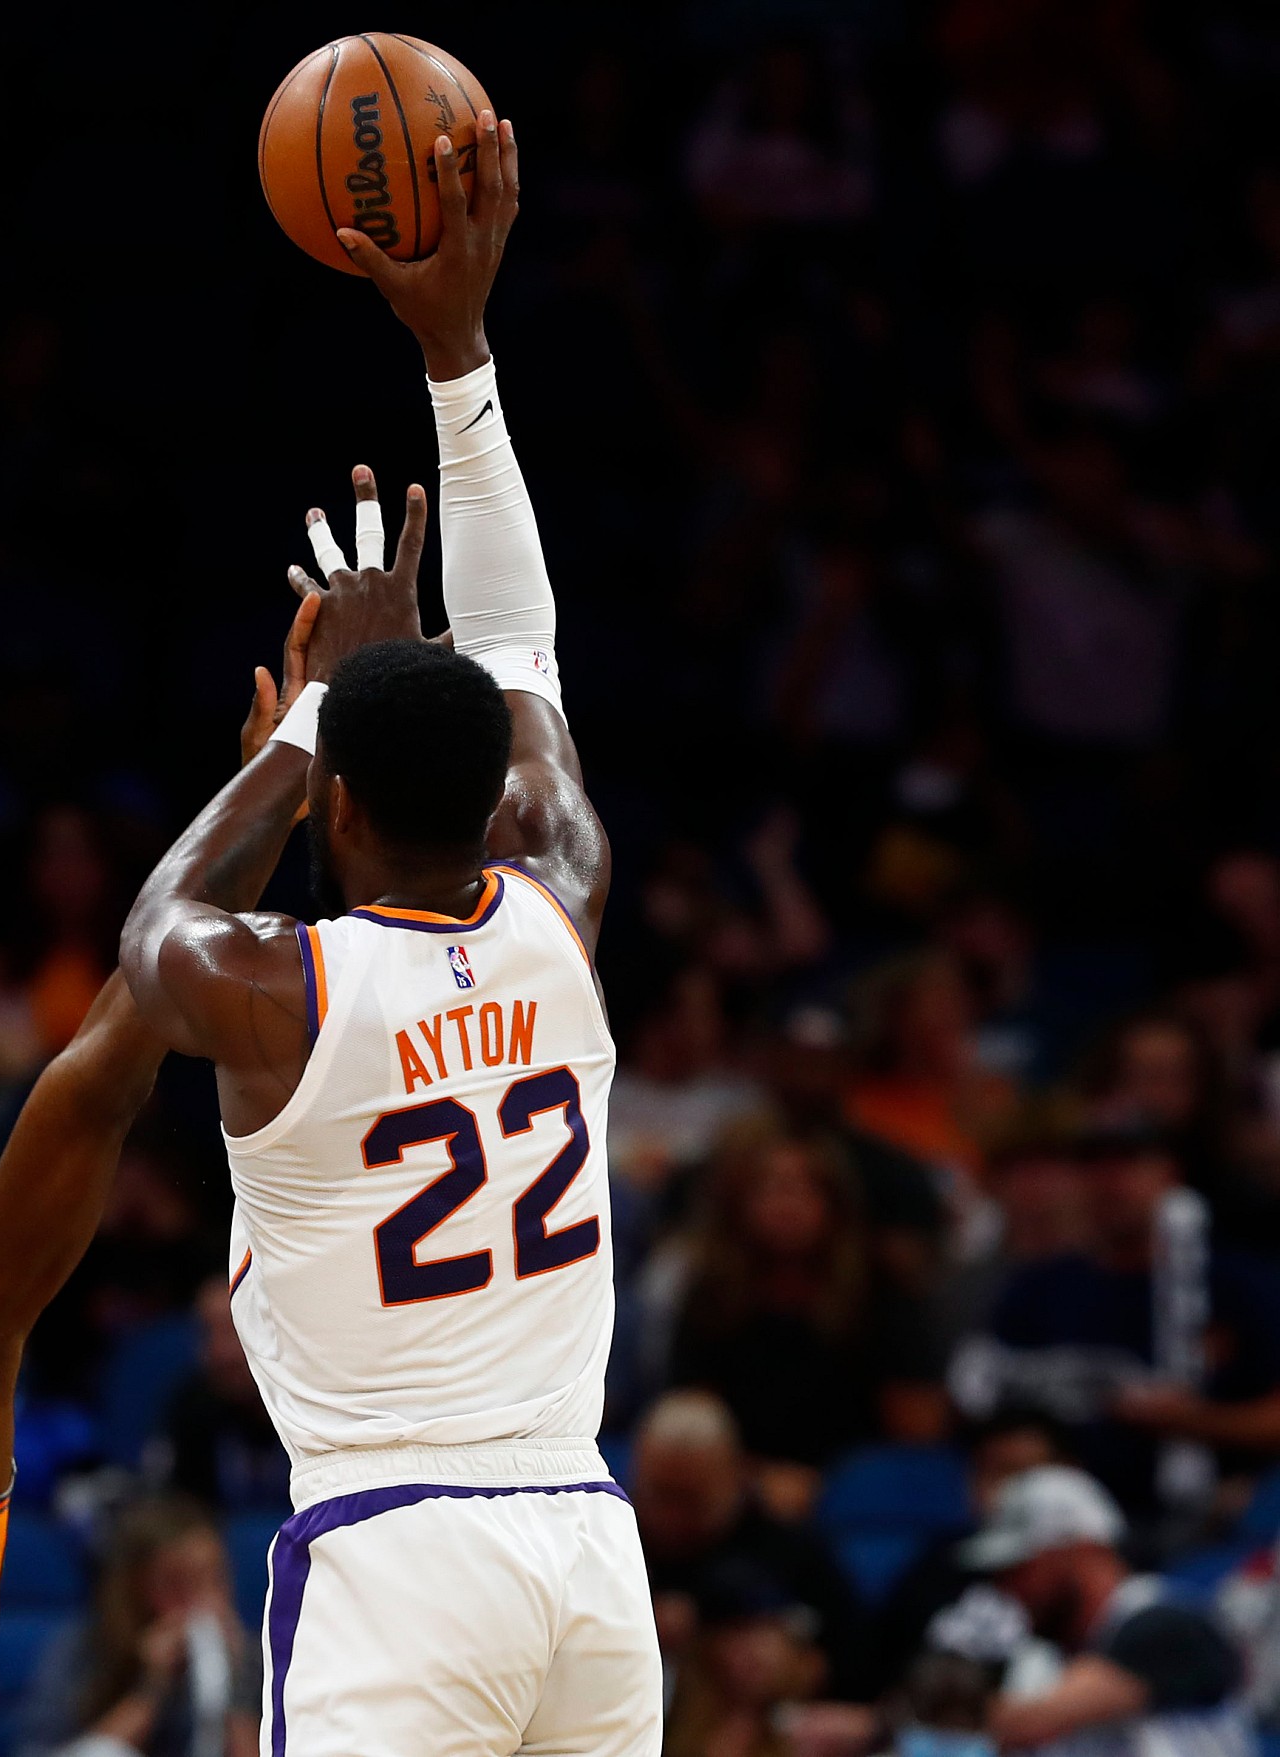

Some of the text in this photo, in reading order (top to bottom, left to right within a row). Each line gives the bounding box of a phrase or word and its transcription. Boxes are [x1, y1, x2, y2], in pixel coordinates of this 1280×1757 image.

[345, 92, 401, 249] Wilson
[395, 1000, 537, 1094] AYTON
[360, 1065, 600, 1307] 22
